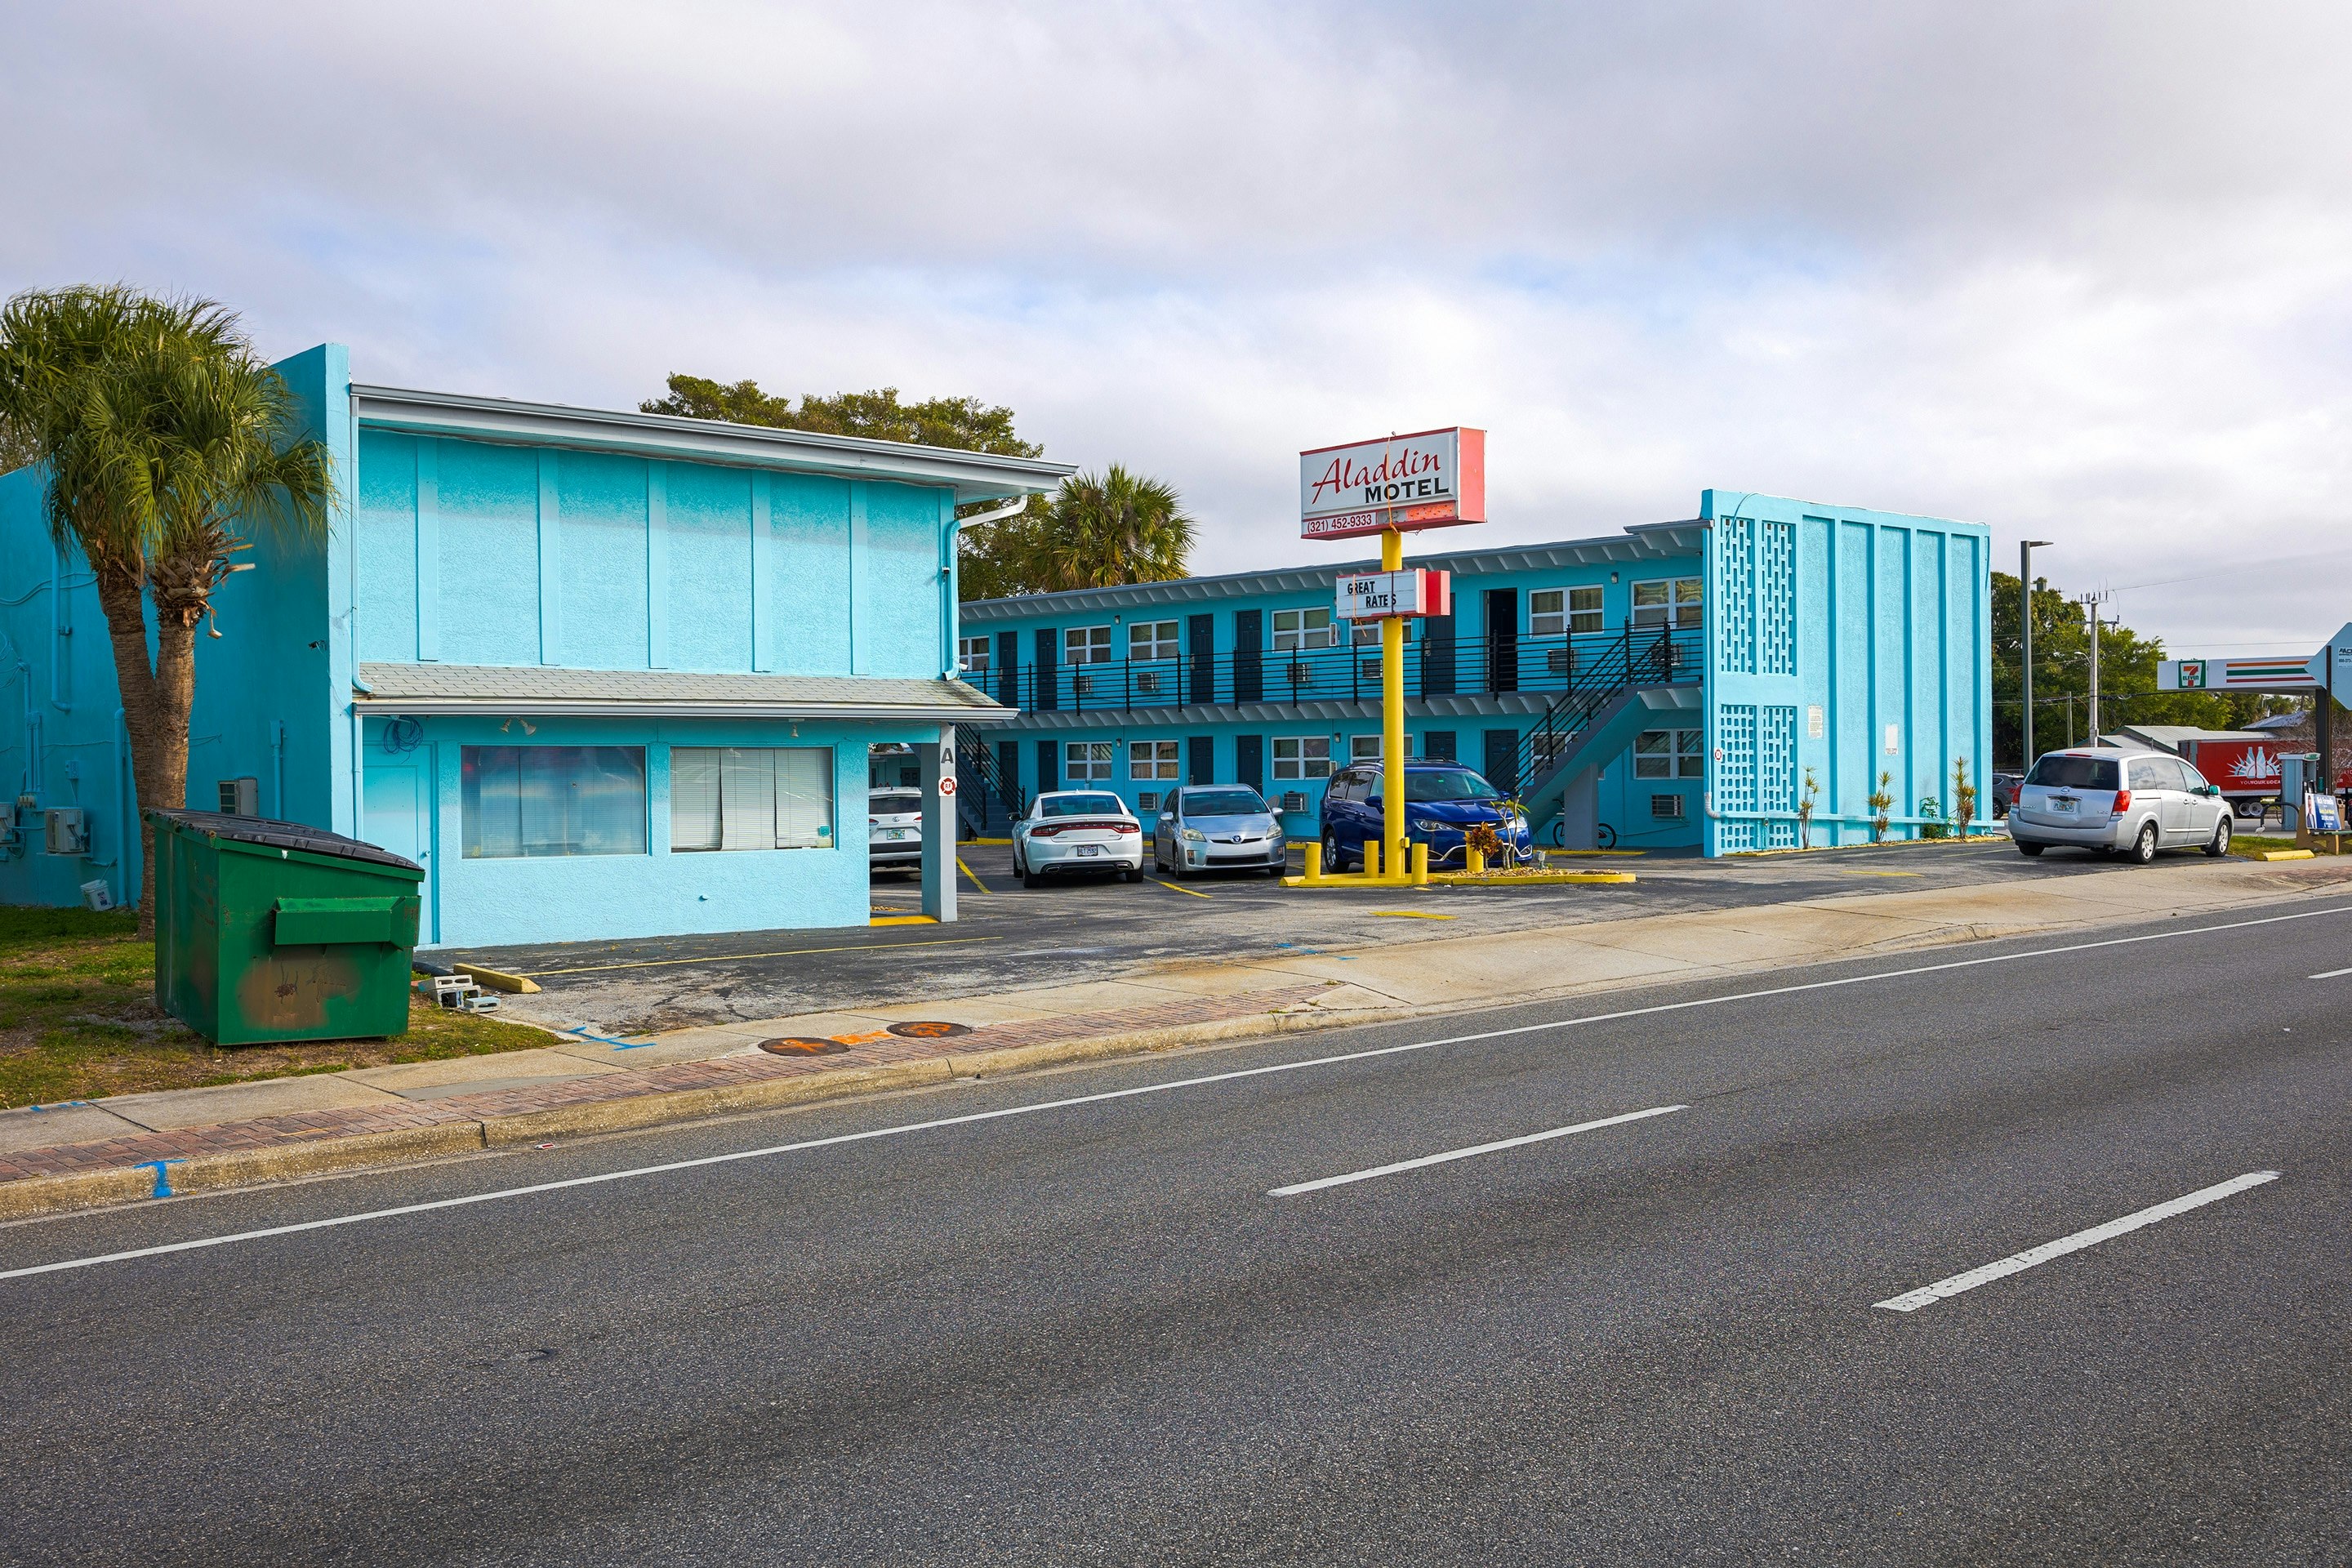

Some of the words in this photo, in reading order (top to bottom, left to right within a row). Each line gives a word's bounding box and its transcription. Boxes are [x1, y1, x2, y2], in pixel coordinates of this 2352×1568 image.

[1312, 448, 1441, 505] Aladdin
[1365, 477, 1449, 504] MOTEL
[1307, 519, 1329, 535] (321)
[1331, 514, 1372, 530] 452-9333
[1348, 581, 1375, 595] GREAT
[941, 747, 954, 764] A
